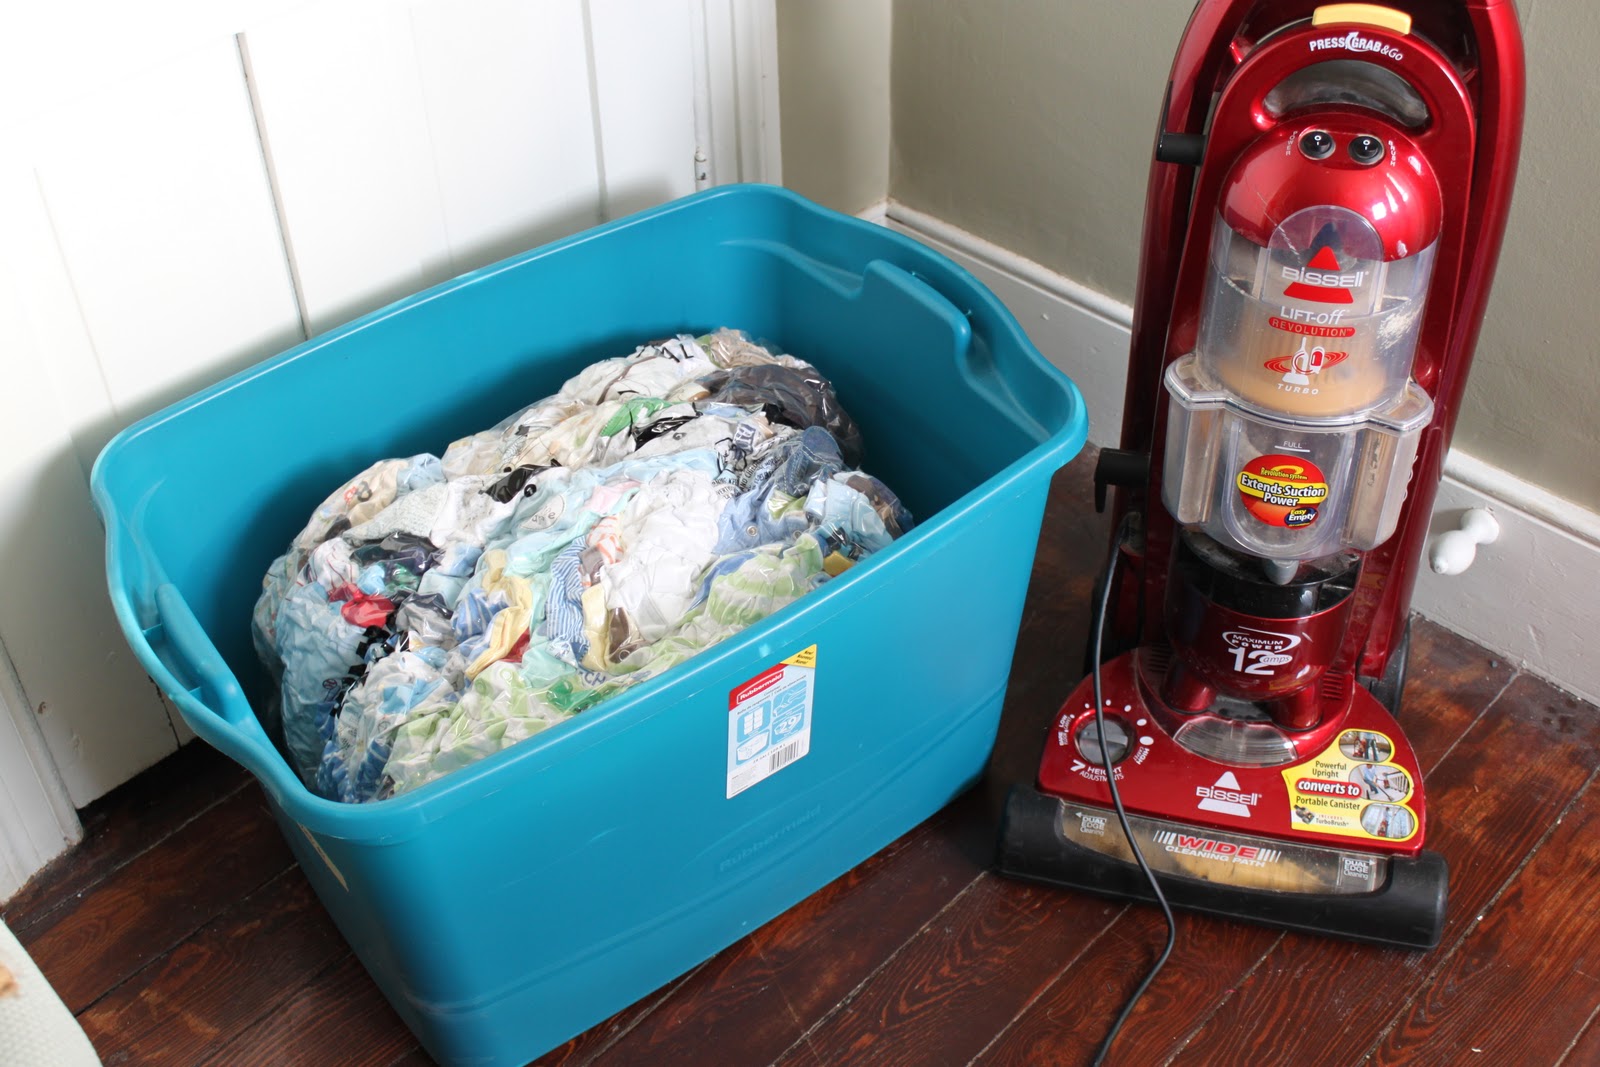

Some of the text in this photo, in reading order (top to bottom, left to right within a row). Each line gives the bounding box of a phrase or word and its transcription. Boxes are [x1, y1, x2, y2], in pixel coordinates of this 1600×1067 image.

[1271, 318, 1347, 337] REVOLUTION
[1277, 383, 1319, 395] TURBO
[1282, 440, 1303, 449] FULL
[1260, 466, 1289, 478] Revolution
[1241, 474, 1325, 497] Extends Suction
[1263, 492, 1299, 507] Power
[1288, 513, 1317, 521] Empty
[1231, 639, 1283, 650] POWER
[1232, 634, 1284, 645] MAXIMUM
[1227, 647, 1275, 676] 12
[1263, 655, 1291, 664] amps
[740, 673, 782, 700] Rubbermaid
[779, 715, 797, 730] 29
[1315, 760, 1347, 771] Powerful
[1312, 768, 1339, 778] Upright
[1298, 780, 1360, 796] converts to
[1296, 795, 1361, 810] Portable Canister
[1177, 833, 1260, 860] WIDE
[1165, 845, 1266, 868] CLEANING PATH
[1344, 860, 1369, 868] DUAL
[1344, 864, 1369, 874] EDGE
